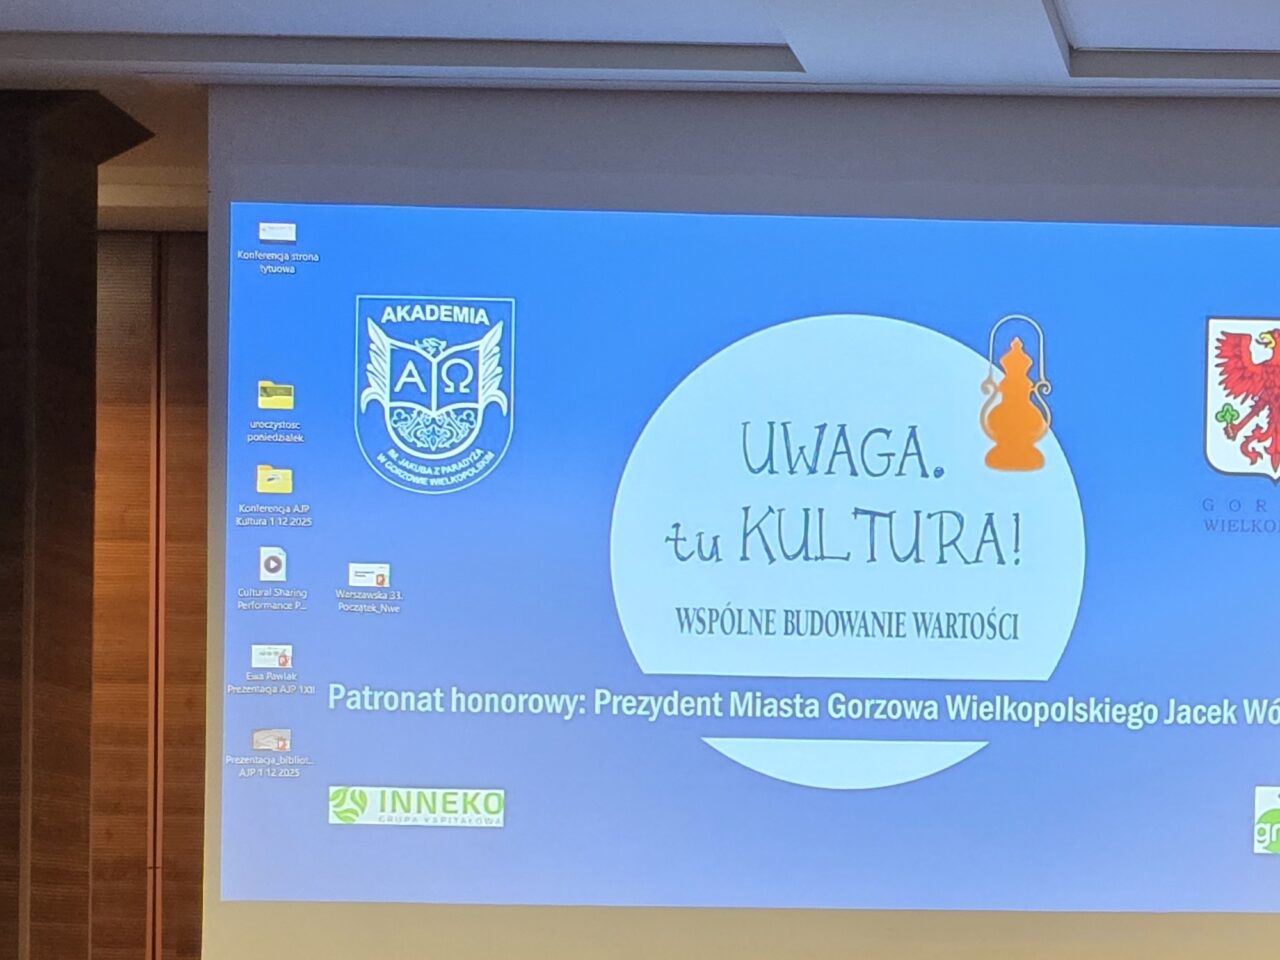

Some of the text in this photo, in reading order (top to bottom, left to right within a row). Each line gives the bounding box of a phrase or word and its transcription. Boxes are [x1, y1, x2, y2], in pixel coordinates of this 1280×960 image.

[237, 250, 320, 262] Konferencja strona
[381, 304, 490, 326] AKADEMIA
[741, 421, 945, 479] UWAGA.
[385, 460, 429, 485] GORZOWIE
[398, 458, 433, 475] JAKUBA
[238, 504, 310, 515] Konferencja AJP
[235, 516, 267, 526] Kultura
[665, 505, 1021, 566] tu KULTURA!
[237, 588, 307, 599] Cultural Sharing
[335, 589, 388, 600] Warszawska
[237, 601, 293, 611] Performance
[676, 601, 1020, 640] WSPÓLNE BUDOWANIE WARTOŚCI
[280, 685, 297, 694] AJP
[328, 682, 444, 713] Patronat
[450, 686, 586, 720] honorowy:
[594, 688, 723, 722] Prezydent
[730, 691, 820, 719] Miasta
[827, 692, 939, 721] Gorzowa
[946, 694, 1158, 730] Wielkopolskiego
[1163, 698, 1237, 726] Jacek
[239, 768, 256, 777] AJP
[380, 790, 504, 815] INNEKO
